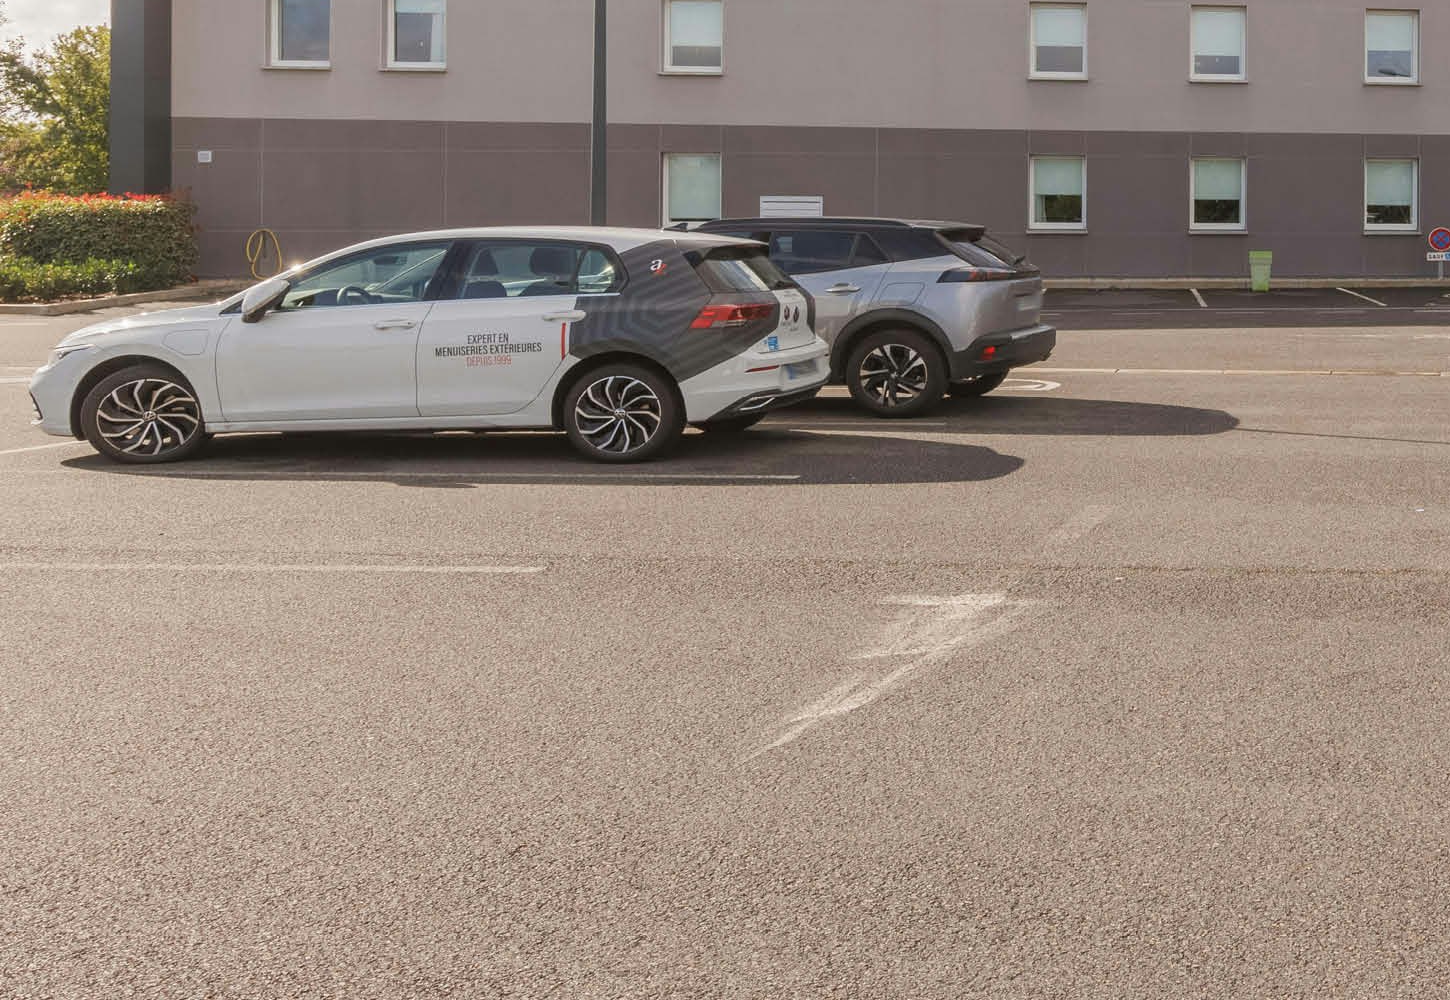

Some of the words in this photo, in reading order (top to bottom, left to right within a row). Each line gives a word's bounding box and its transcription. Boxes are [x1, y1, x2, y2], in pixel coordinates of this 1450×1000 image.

[467, 333, 497, 345] EXPERT
[498, 332, 509, 344] EN
[435, 344, 489, 357] MENUISERIES
[466, 356, 493, 368] DEPUIS
